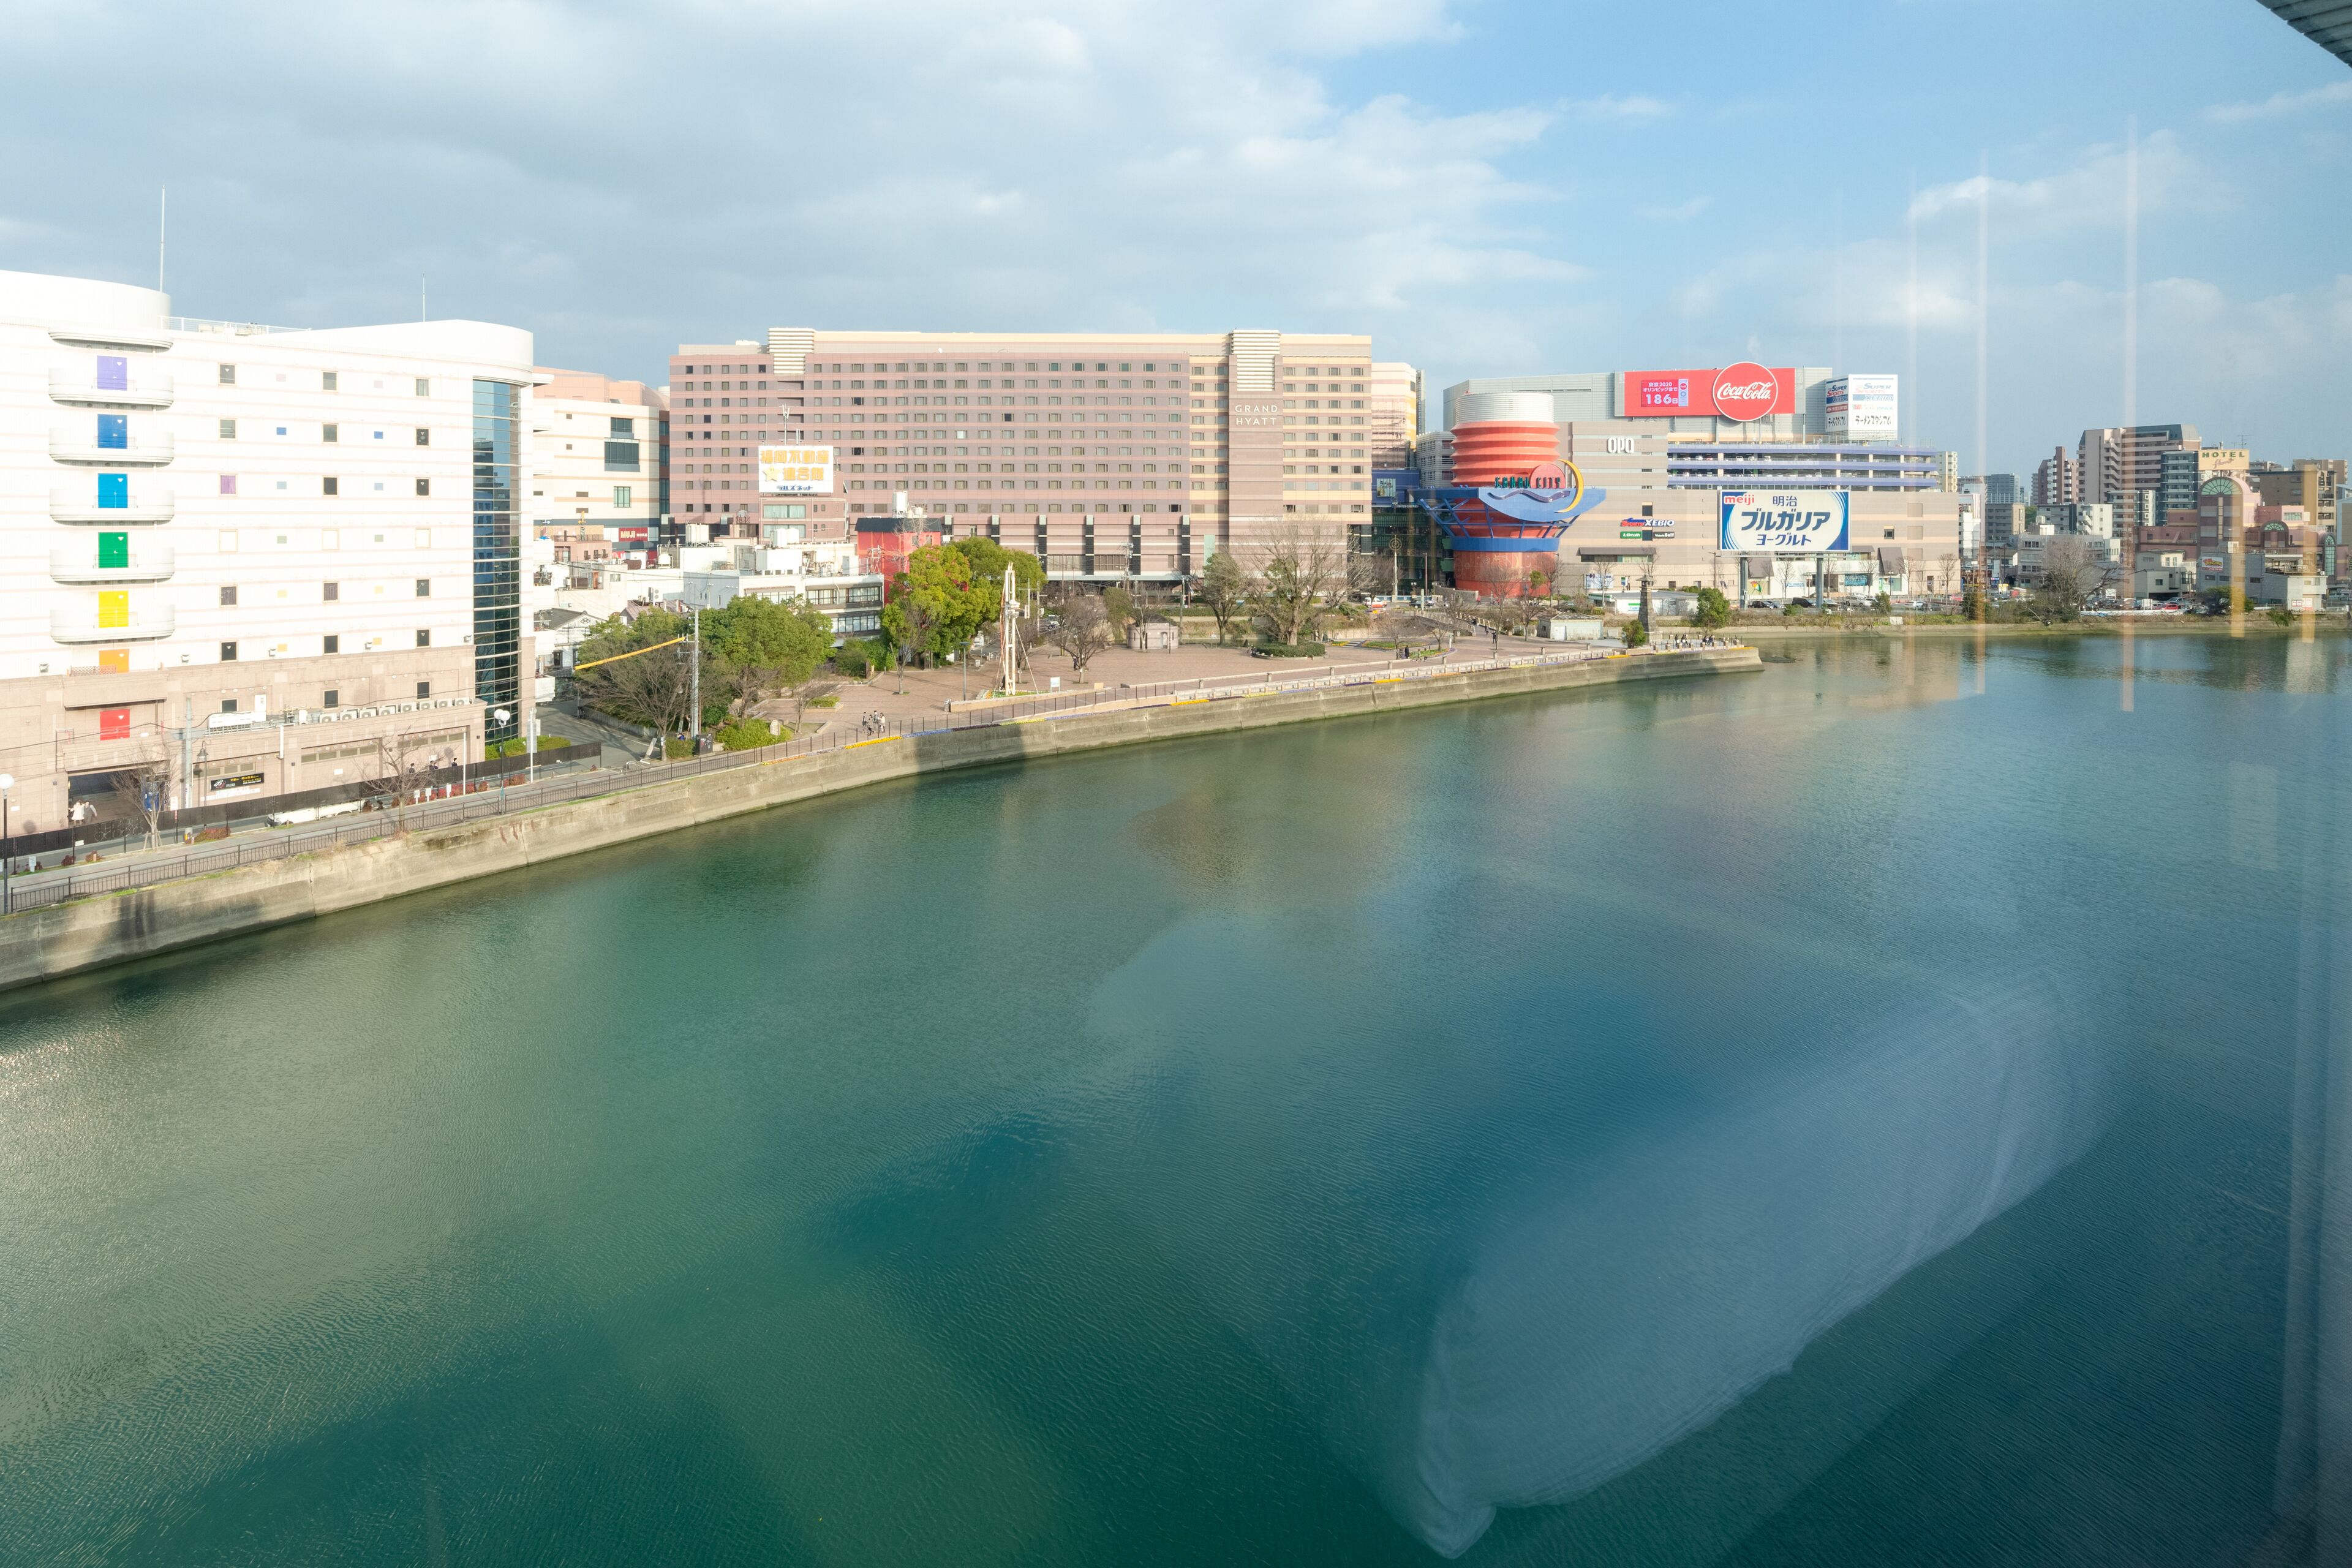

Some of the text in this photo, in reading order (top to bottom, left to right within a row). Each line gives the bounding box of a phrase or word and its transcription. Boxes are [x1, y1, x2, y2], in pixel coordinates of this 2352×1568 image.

[1716, 382, 1774, 400] Coca-Cola
[1646, 394, 1678, 404] 186日
[760, 450, 829, 464] 福岡不動産
[1494, 477, 1561, 488] CANAL CITY
[1724, 494, 1755, 505] meiji
[1773, 496, 1798, 507] 明治
[1741, 508, 1831, 531] ブルガリア
[1756, 532, 1811, 546] ヨーグルト
